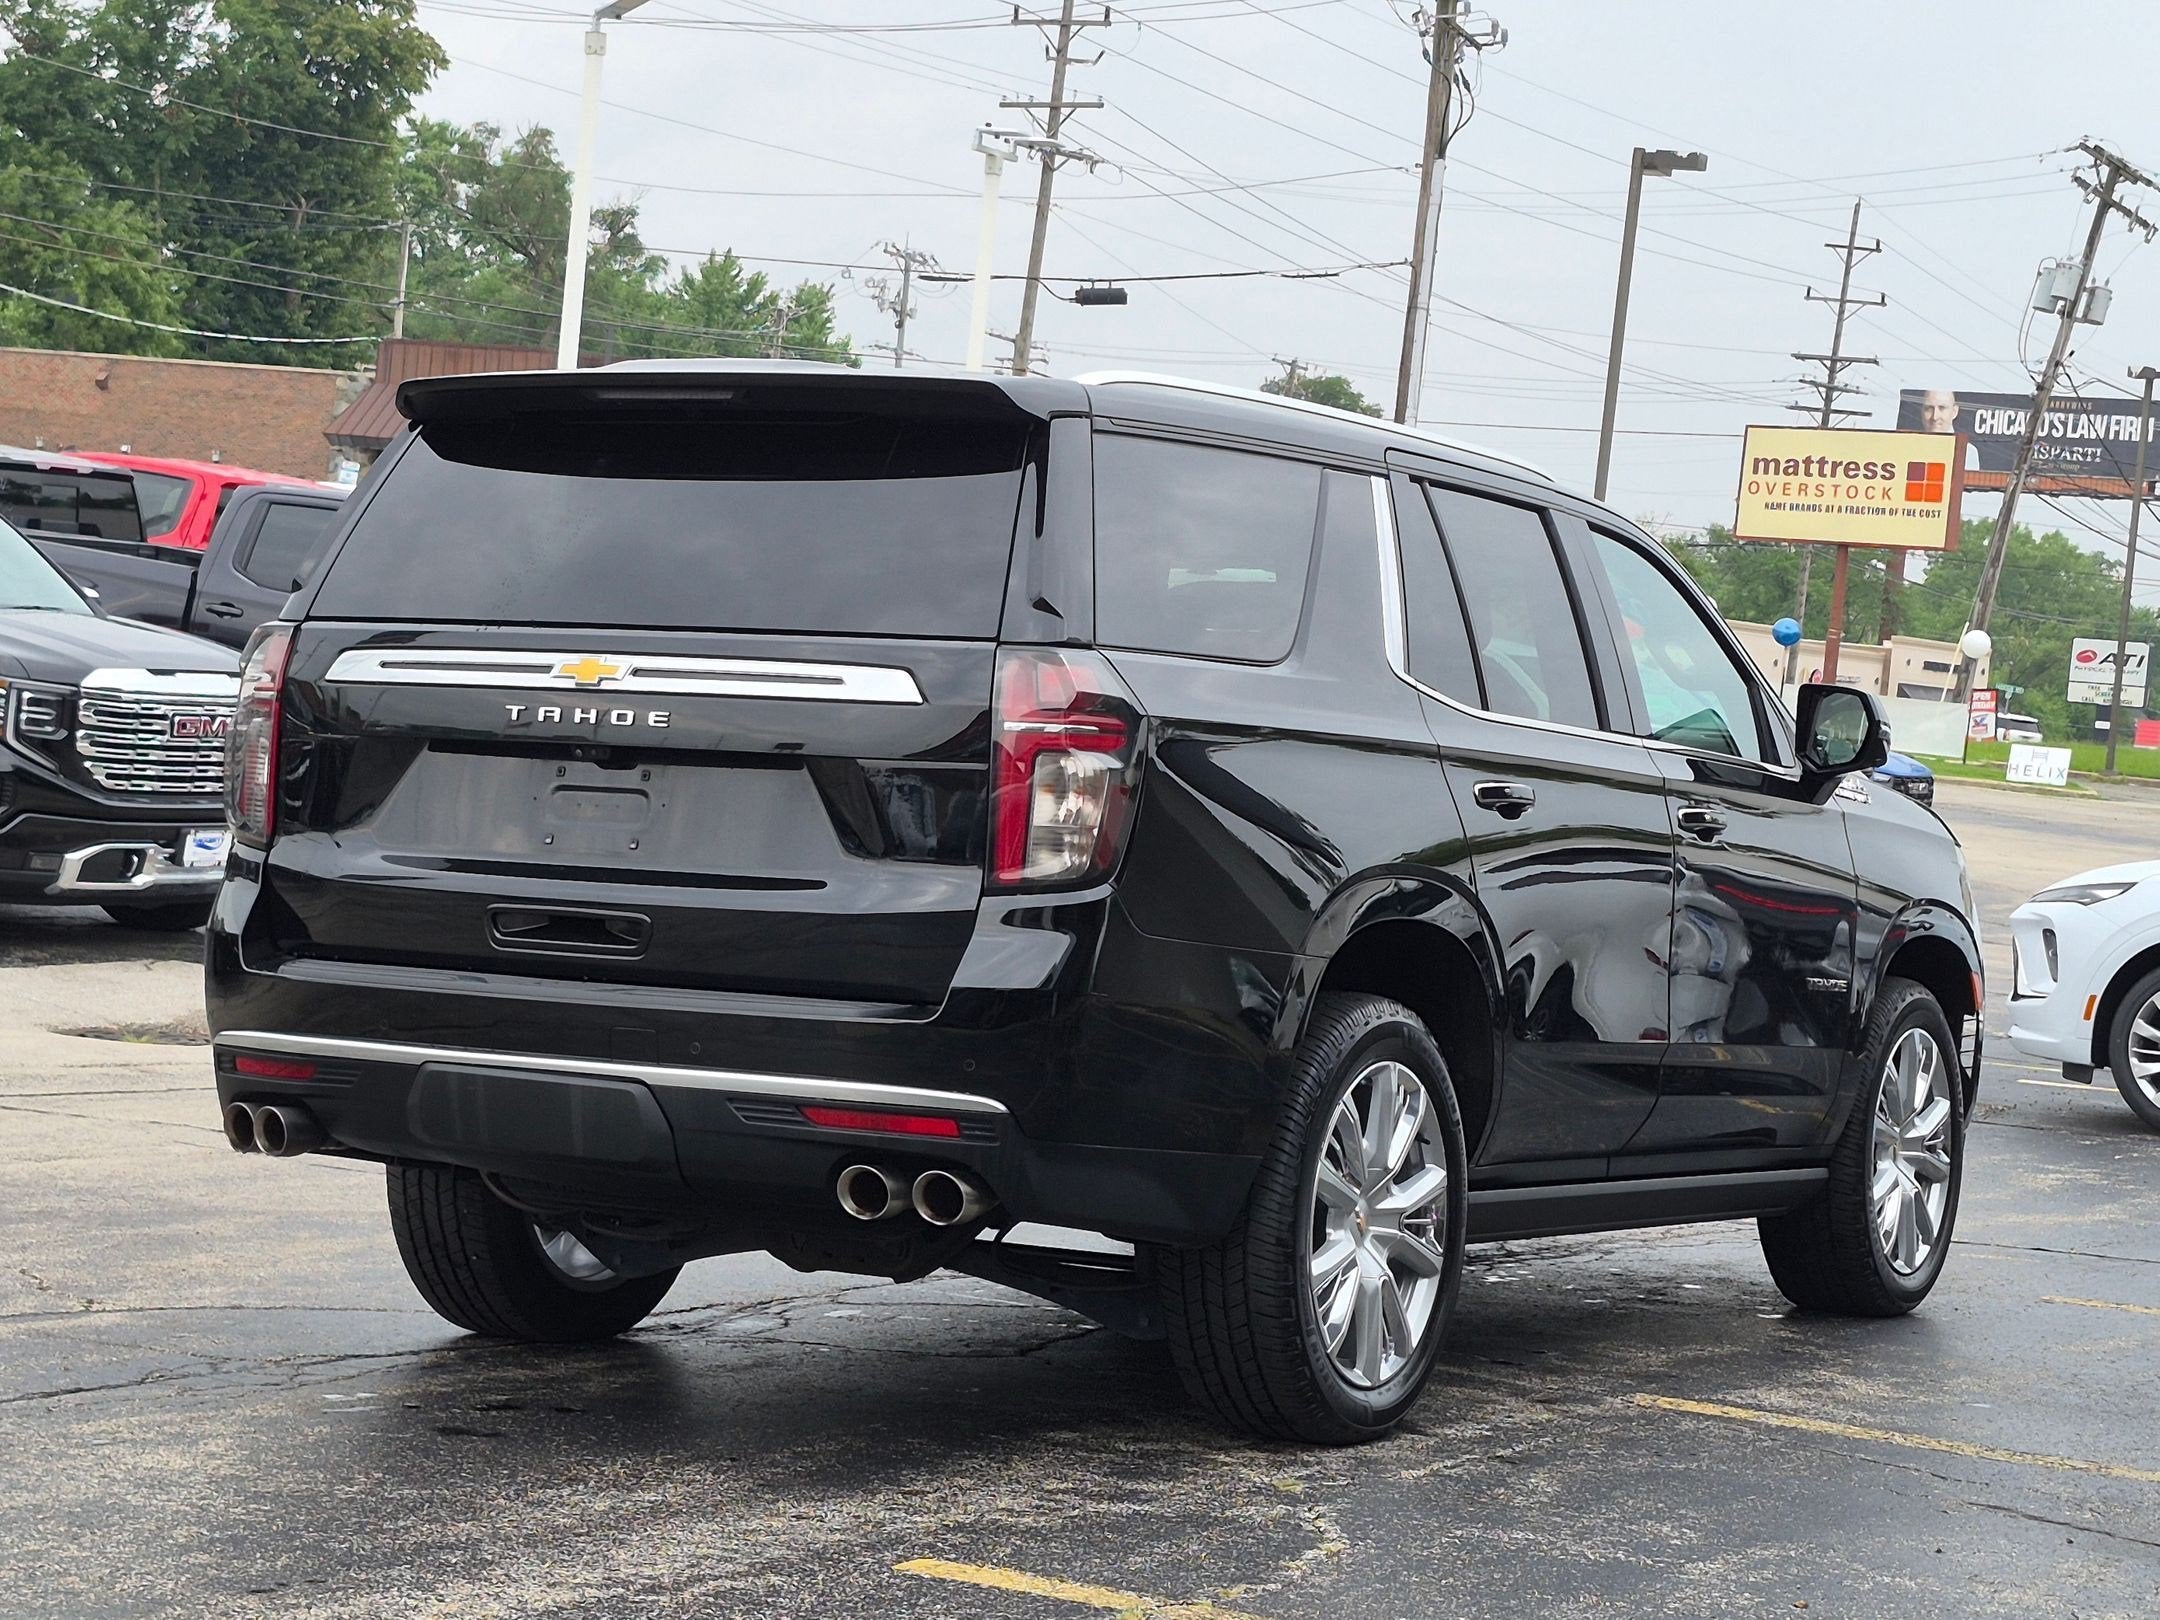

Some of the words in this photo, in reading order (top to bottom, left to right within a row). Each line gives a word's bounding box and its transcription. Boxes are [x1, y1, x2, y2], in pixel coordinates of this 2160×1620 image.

[1974, 409, 2065, 438] CHICAO'S
[2066, 413, 2108, 439] LAW
[1752, 455, 1896, 481] mattress
[1748, 480, 1893, 501] OVERSTOCK
[1764, 501, 1787, 512] NAME
[1789, 503, 1823, 513] BRANDS
[1825, 505, 1834, 514] AT
[1837, 506, 1842, 514] A
[1844, 506, 1886, 516] FRACTION
[1888, 507, 1900, 516] OF
[1902, 508, 1916, 517] THE
[1919, 509, 1942, 519] COST
[174, 716, 231, 738] GM
[505, 705, 672, 728] TAHOE
[2008, 763, 2067, 779] HELIX
